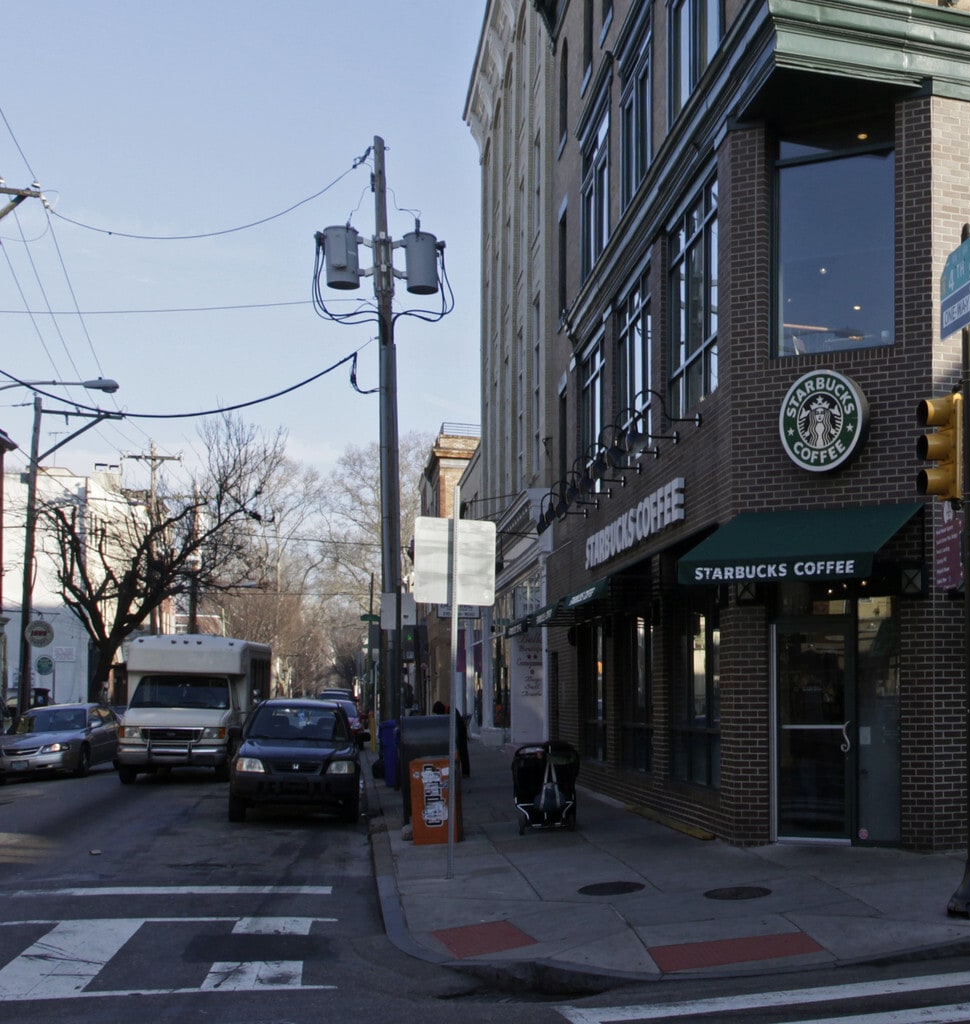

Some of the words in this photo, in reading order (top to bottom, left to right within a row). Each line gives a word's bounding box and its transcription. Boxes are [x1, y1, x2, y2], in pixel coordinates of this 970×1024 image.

[786, 377, 855, 418] STARBUCKS
[793, 439, 846, 464] COFFEE
[585, 508, 637, 571] STARBUCKS
[636, 477, 685, 542] COFFEE
[694, 563, 787, 580] STARBUCKS
[793, 560, 855, 575] COFFEE
